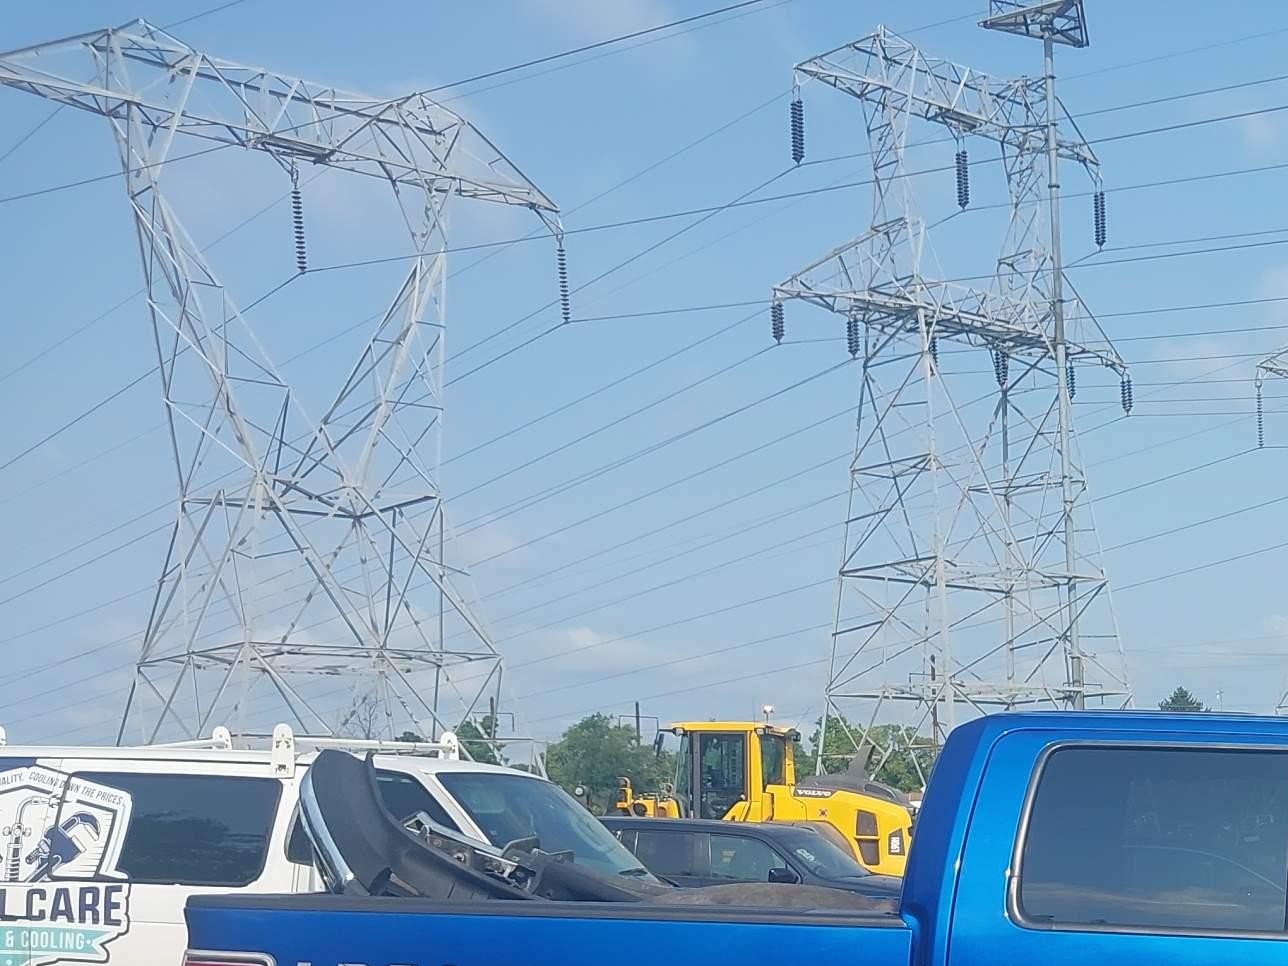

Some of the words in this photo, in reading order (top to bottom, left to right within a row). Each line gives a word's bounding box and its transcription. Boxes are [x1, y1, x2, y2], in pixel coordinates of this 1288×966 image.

[0, 772, 25, 785] ALITY.
[58, 780, 81, 793] DWN
[81, 785, 96, 797] THE
[96, 789, 123, 806] PRICES
[797, 789, 832, 797] VOLVO
[26, 885, 122, 926] CARE
[5, 930, 14, 948] &
[21, 930, 85, 950] COOLING
